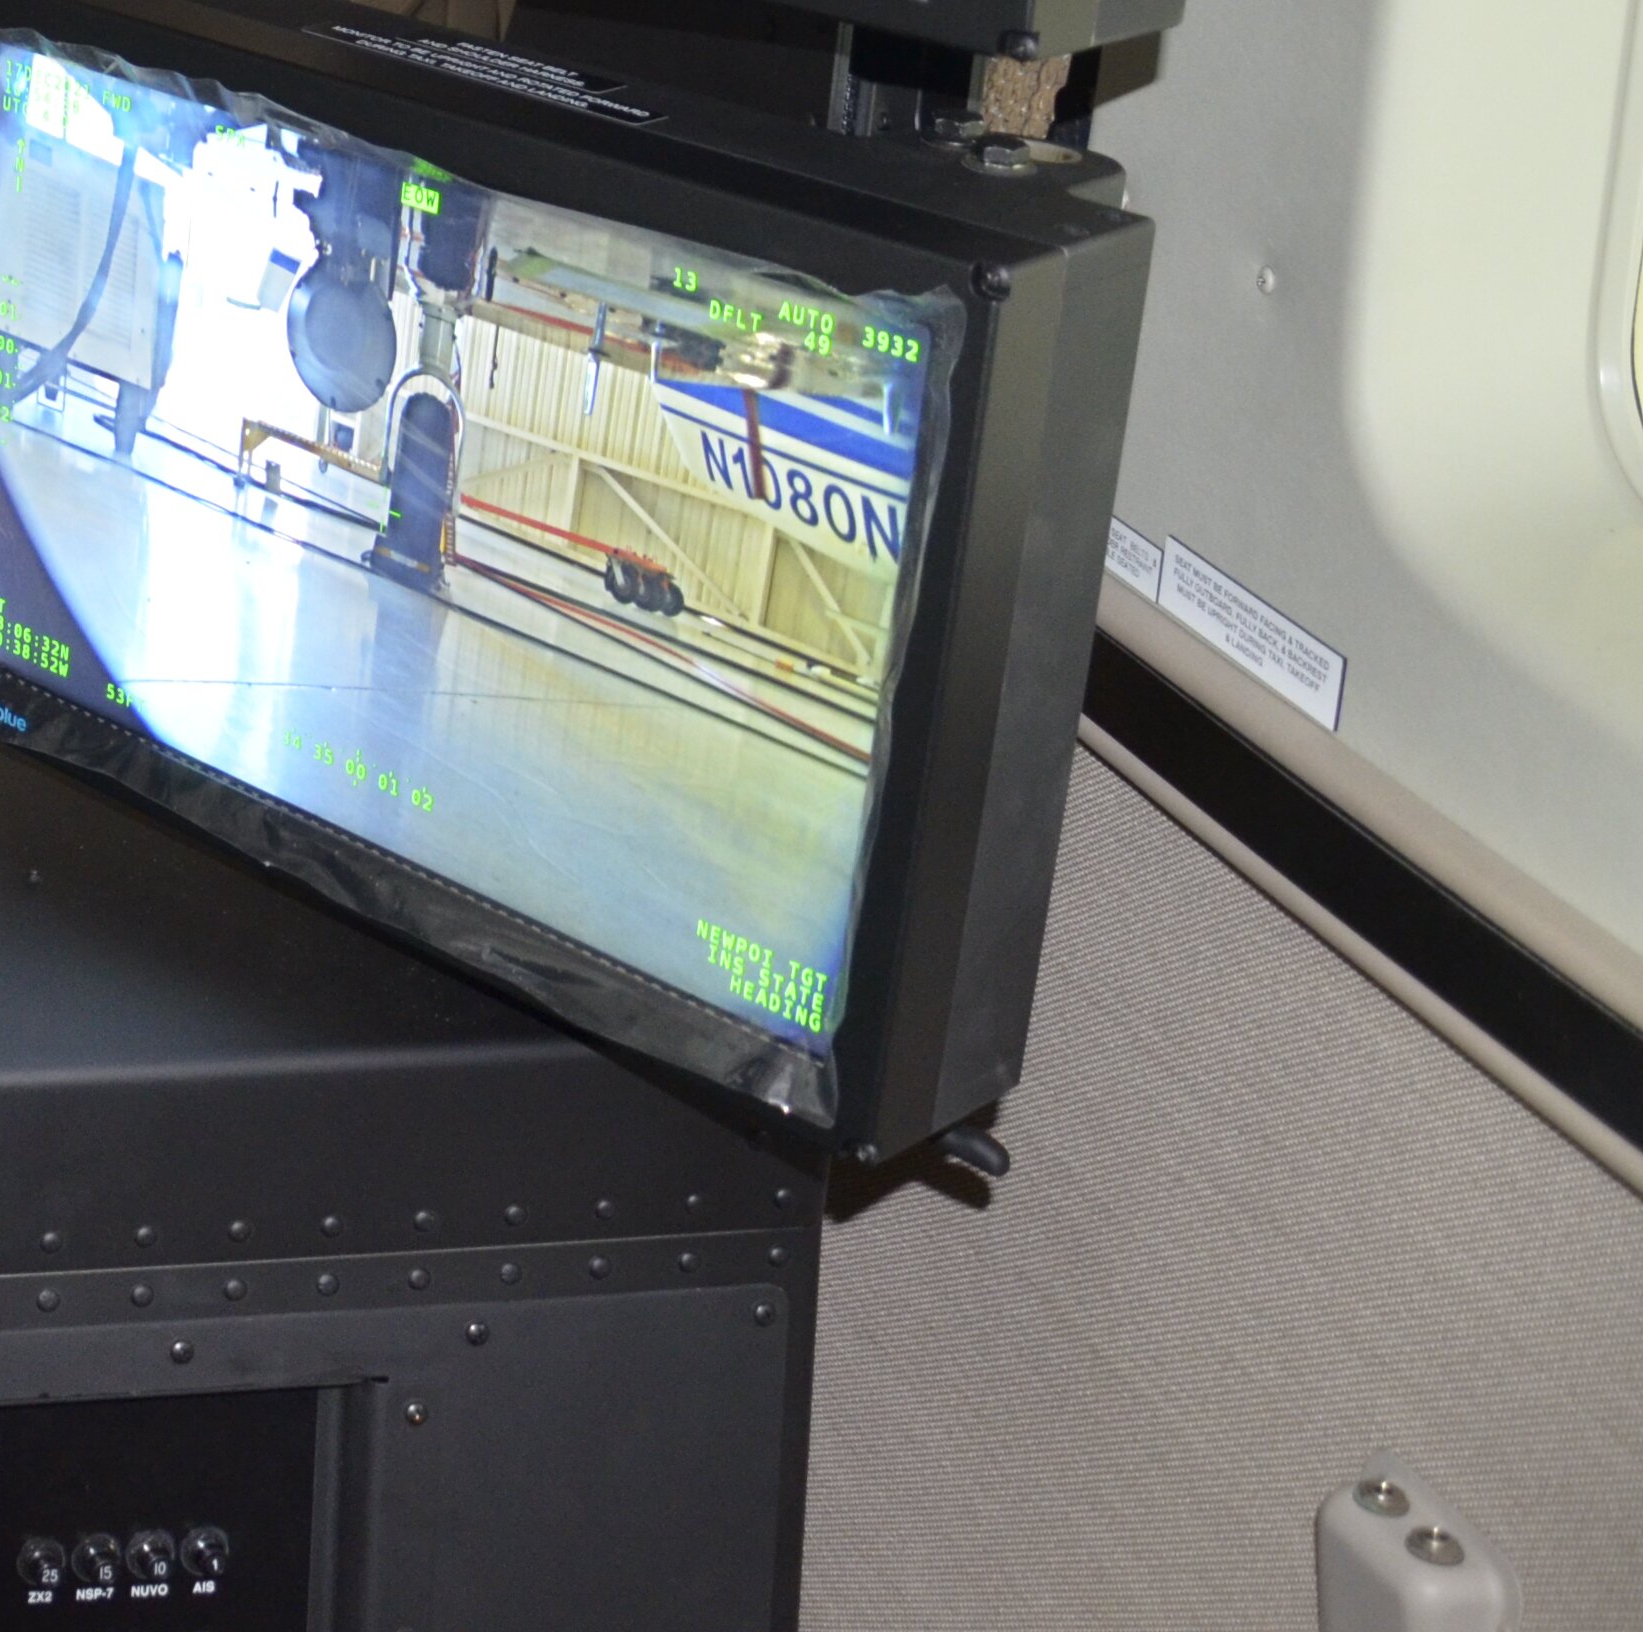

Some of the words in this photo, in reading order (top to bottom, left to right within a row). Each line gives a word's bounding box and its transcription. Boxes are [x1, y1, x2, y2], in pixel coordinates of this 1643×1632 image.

[355, 39, 407, 58] DURING
[441, 63, 500, 81] TAKEOFF
[498, 79, 528, 91] AND
[418, 39, 447, 49] AND
[507, 55, 544, 68] SEAT
[331, 26, 392, 44] MONITOR
[393, 41, 410, 50] TO
[411, 48, 432, 56] BE
[431, 52, 491, 73] UPRIGHT
[491, 68, 518, 79] AND
[517, 76, 581, 97] ROTATED
[582, 94, 650, 117] FORWARD
[102, 90, 132, 113] FWD
[215, 125, 247, 148] SPA
[403, 185, 437, 209] EOW
[673, 267, 698, 291] 13
[778, 301, 834, 334] AUTO
[863, 326, 920, 362] 3932
[709, 300, 763, 332] DFLT
[804, 331, 831, 356] 49
[700, 430, 901, 562] N1080N
[1174, 568, 1194, 587] FULLY
[1236, 612, 1257, 633] FULLY
[1287, 650, 1327, 683] BACKREST
[1175, 554, 1192, 572] SEAT
[1193, 567, 1212, 586] MUST
[1213, 582, 1223, 595] BE
[1224, 589, 1258, 620] FORWARD
[1260, 613, 1287, 640] FACING
[1295, 639, 1329, 670] TRACKED
[1177, 583, 1196, 602] MUST
[1197, 599, 1206, 611] BE
[1208, 605, 1238, 634] UPRIGHT
[1239, 628, 1266, 654] DURING
[1286, 663, 1320, 691] TAKEOFF
[1231, 638, 1263, 667] LANDING
[313, 743, 334, 765] 35
[345, 757, 366, 781] 00
[378, 774, 399, 797] 01
[411, 788, 434, 812] 02
[696, 919, 774, 969] NEWPOI
[789, 960, 827, 992] TGT
[708, 944, 745, 976] INS
[759, 968, 824, 1014] STATE
[730, 975, 822, 1033] HEADING
[28, 1591, 53, 1604] ZX2
[76, 1588, 114, 1601] NSP-7
[131, 1585, 168, 1597] NUVO
[193, 1581, 215, 1594] AIS
[42, 1570, 58, 1582] 25
[99, 1566, 112, 1579] 15
[154, 1562, 166, 1576] 10
